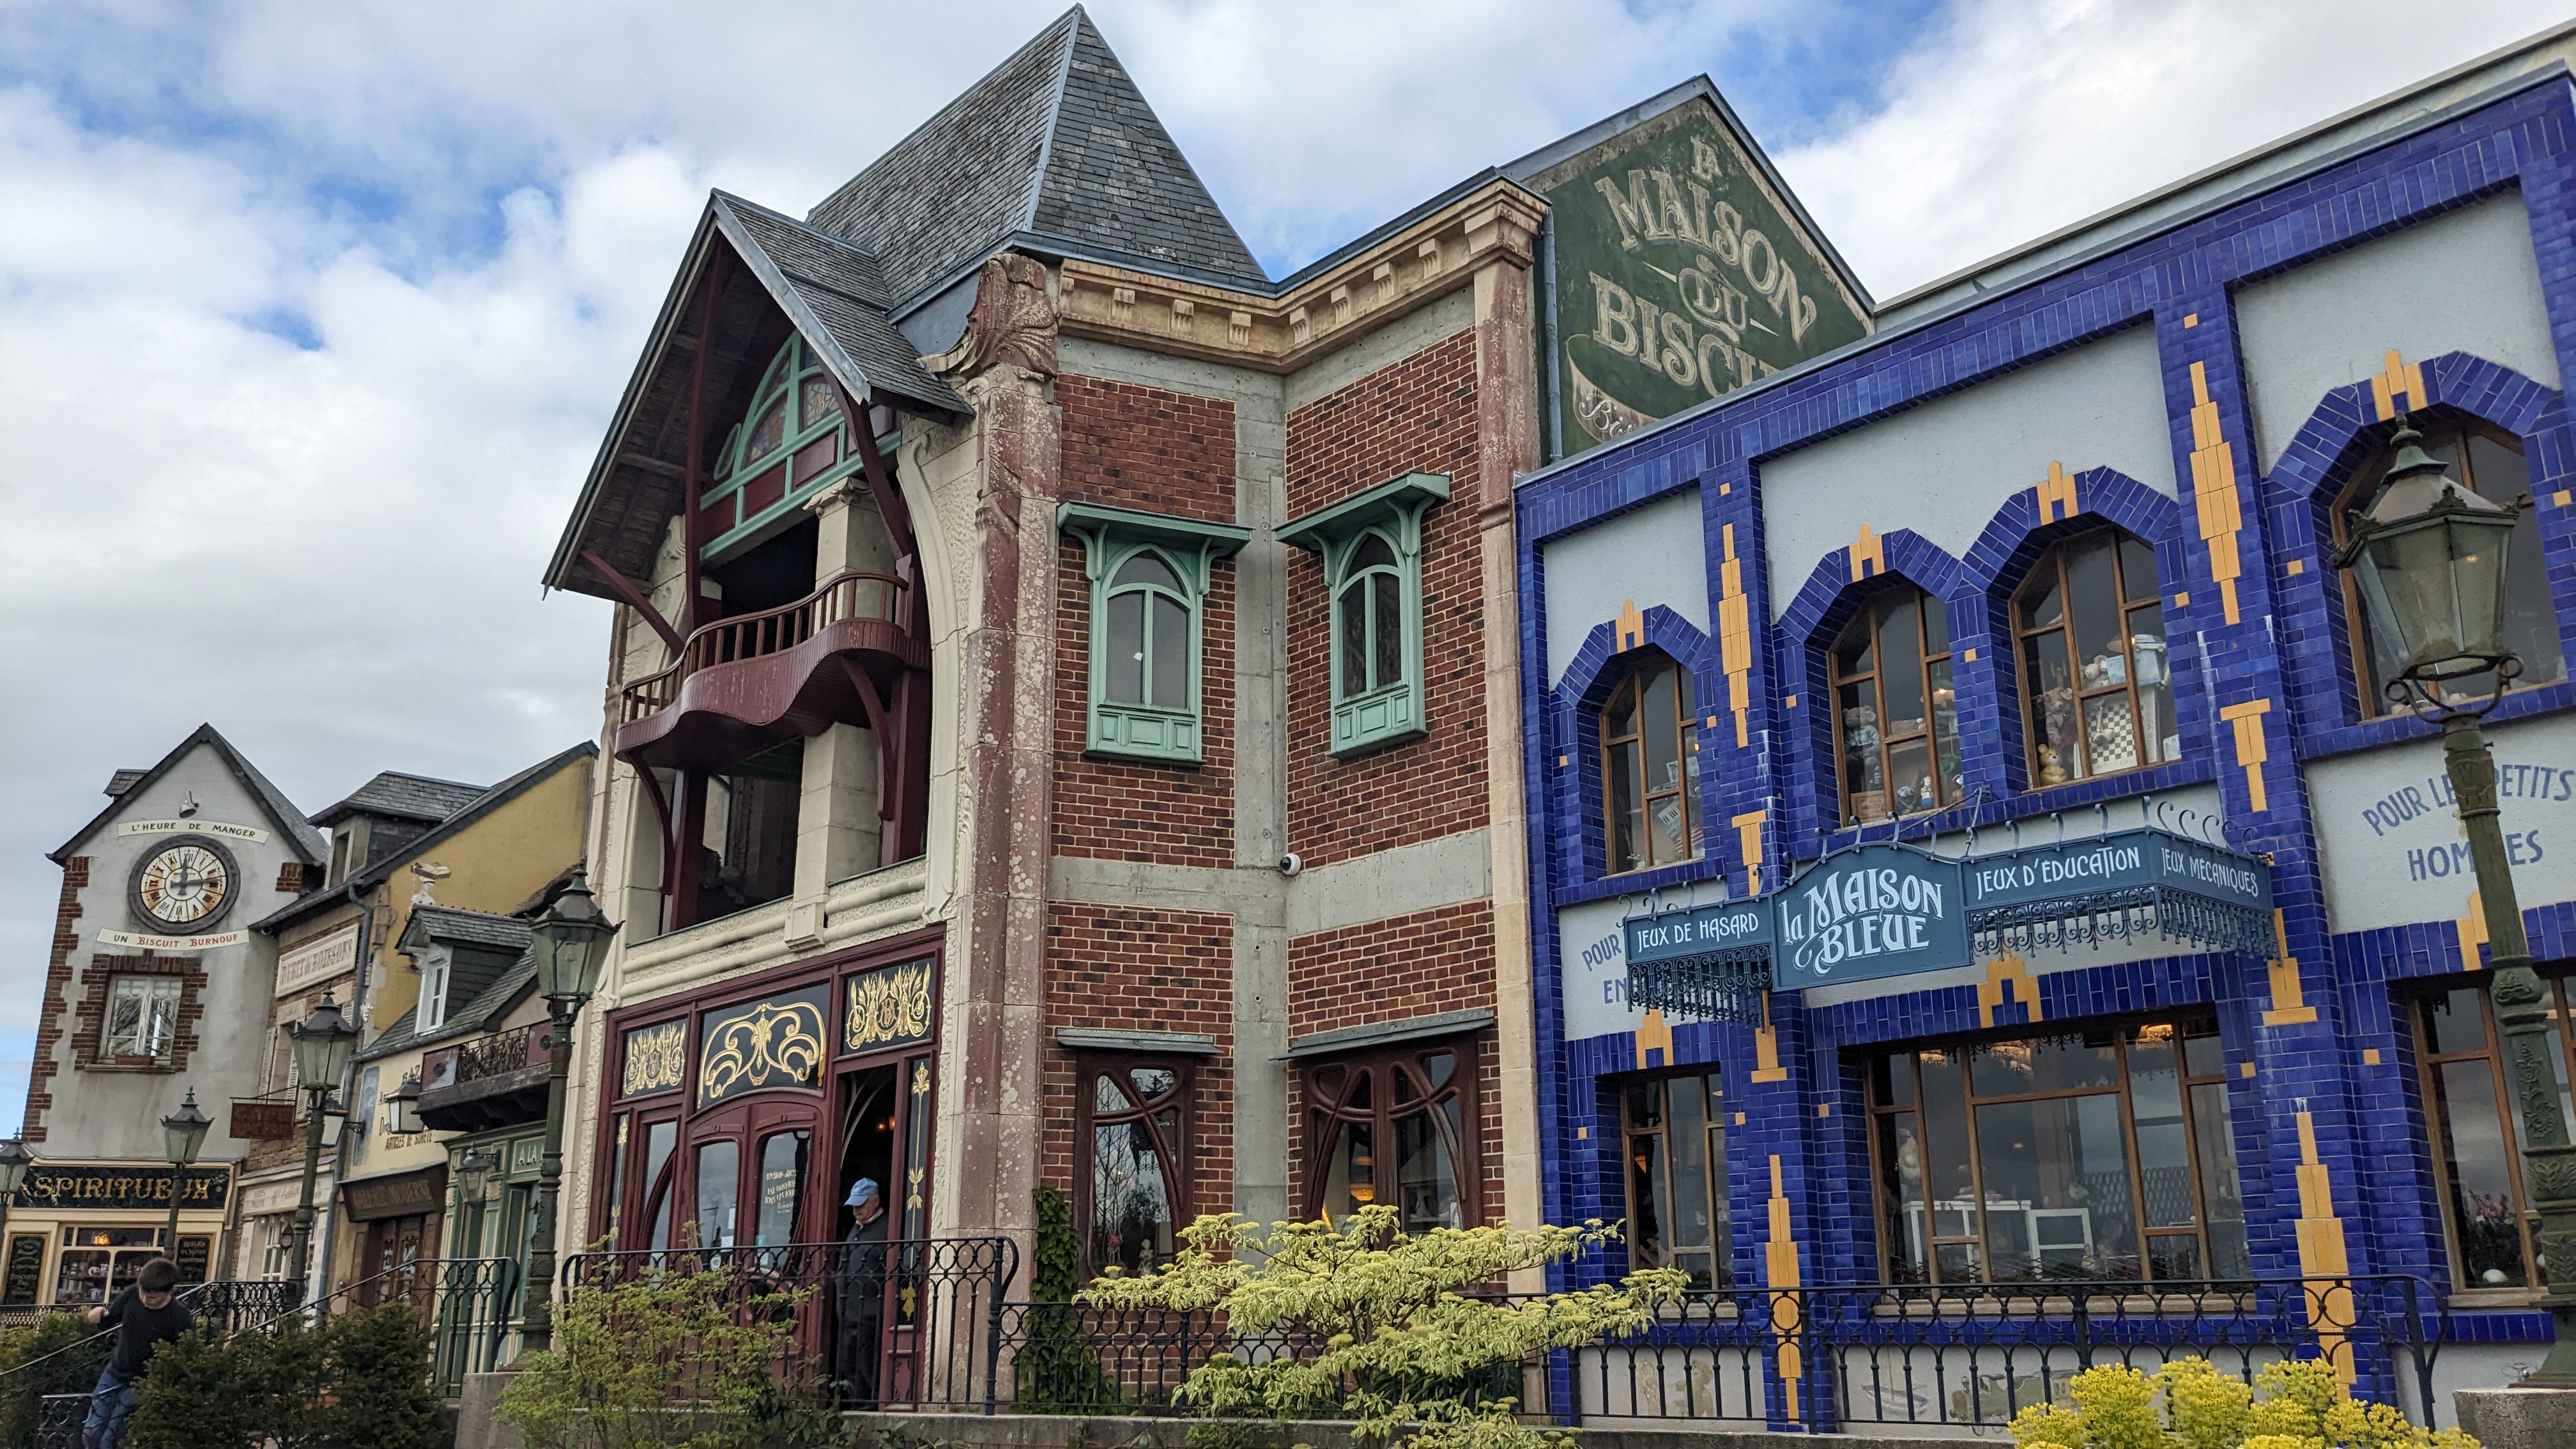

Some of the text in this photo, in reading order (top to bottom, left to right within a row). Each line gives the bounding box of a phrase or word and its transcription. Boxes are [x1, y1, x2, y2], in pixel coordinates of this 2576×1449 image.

[1595, 169, 1817, 344] MAISON
[1678, 255, 1749, 345] DU
[1590, 271, 1781, 398] BISC
[2361, 765, 2575, 836] POUR LE ETITS
[132, 822, 176, 832] L'HEURE
[211, 825, 256, 838] MANGER
[2407, 829, 2543, 882] HOMES
[1975, 845, 2142, 900] JEUX D'ÉDUCATION
[2161, 847, 2258, 898] JEUX MÉCANIQUES
[114, 933, 238, 947] UN BISCUIT BURNOUF
[1637, 912, 1758, 953] JEUX DE HASARD
[1793, 868, 1943, 970] MAISON
[1813, 914, 1930, 976] BLEUE
[1581, 933, 1622, 972] POUR
